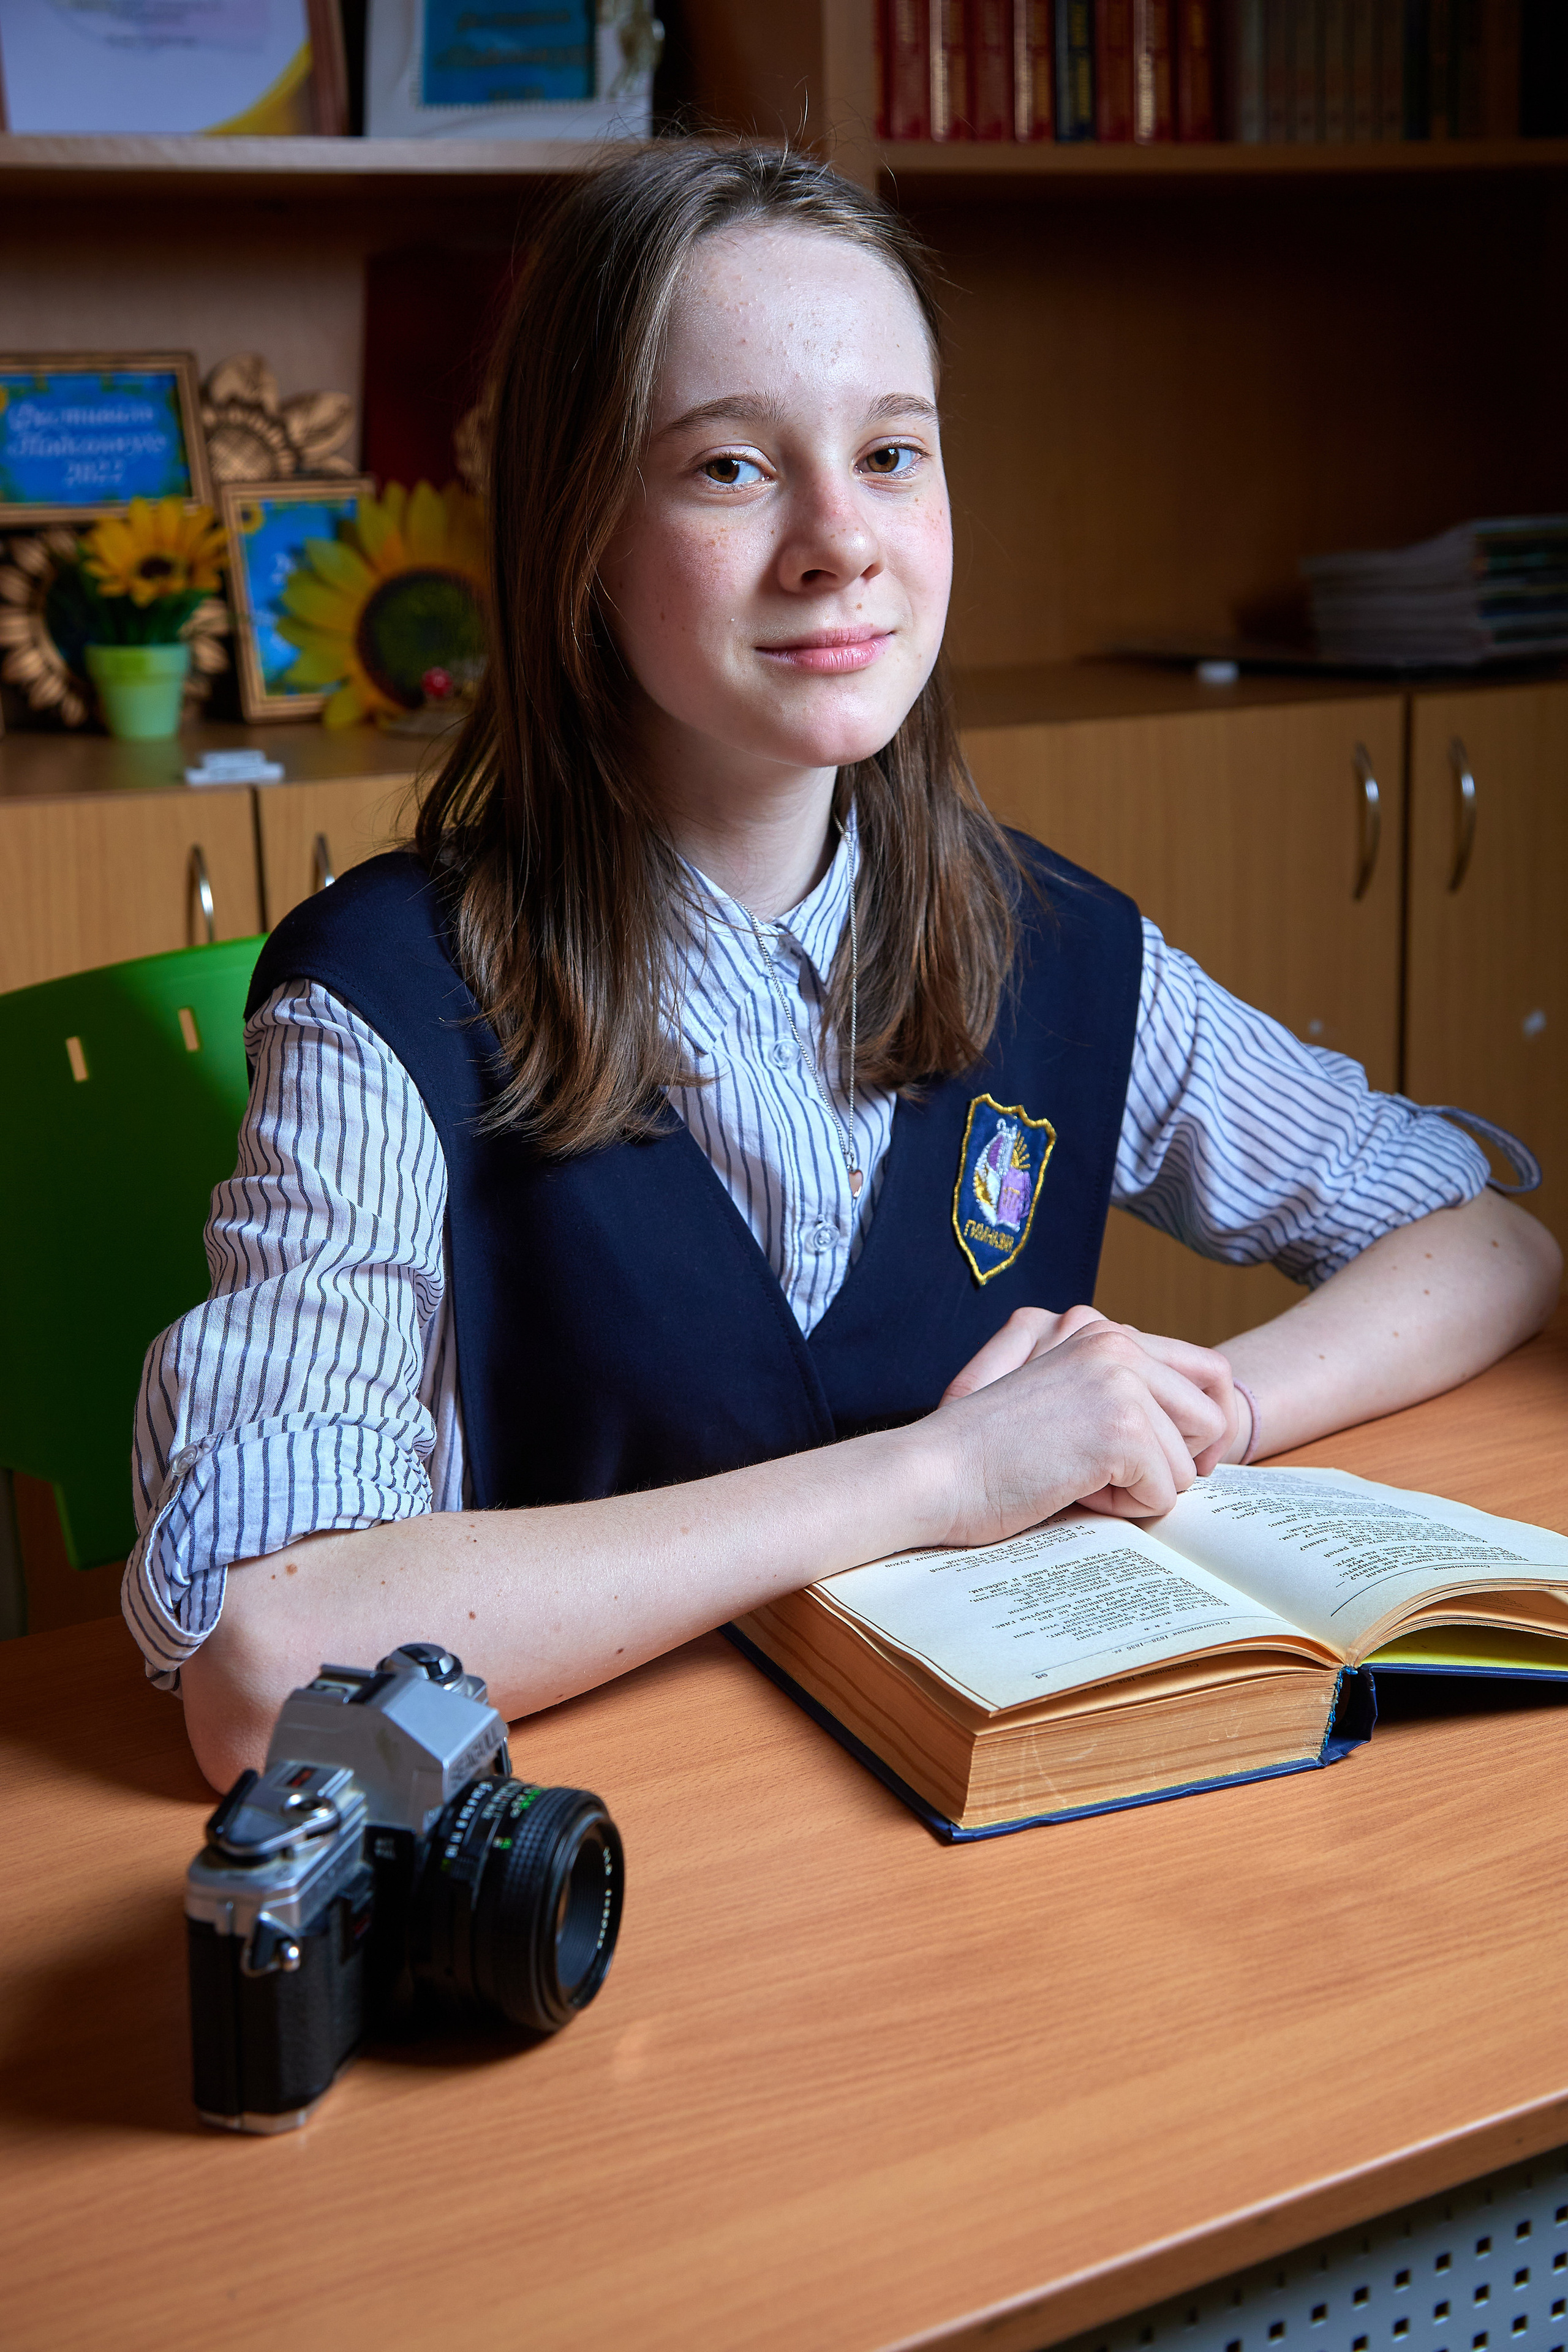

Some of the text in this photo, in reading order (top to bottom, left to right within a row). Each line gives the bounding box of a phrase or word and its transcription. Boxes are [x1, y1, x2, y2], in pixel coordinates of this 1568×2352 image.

[1210, 1500, 1253, 1515] страстей!
[1265, 1518, 1298, 1527] пятно;
[1284, 1524, 1314, 1532] моем;
[1024, 1527, 1066, 1542] Внимали
[1276, 1532, 1299, 1541] том,
[1035, 1536, 1065, 1547] тихую
[1297, 1537, 1329, 1551] дыша?
[1081, 1553, 1109, 1561] чужд
[1322, 1545, 1350, 1558] речей
[983, 1556, 1010, 1564] ангел
[1049, 1560, 1081, 1570] всему,
[1072, 1555, 1120, 1569] возвещает
[1332, 1556, 1357, 1567] звук.
[1344, 1559, 1365, 1567] мук
[928, 1562, 962, 1573] толпой
[1068, 1564, 1102, 1575] башни
[1102, 1563, 1137, 1573] мелкие
[1119, 1563, 1162, 1574] Который
[1336, 1556, 1389, 1577] презирать;
[1346, 1565, 1379, 1580] знать?
[1364, 1564, 1399, 1578] издали
[1020, 1569, 1049, 1578] земле
[1044, 1569, 1070, 1577] миру
[1055, 1572, 1102, 1586] несчастия
[1018, 1567, 1168, 1605] Могильного кургана, мавзолей,
[1025, 1574, 1067, 1588] мрачный
[1050, 1576, 1103, 1592] изменится;
[1133, 1581, 1178, 1593] путникам
[1021, 1585, 1054, 1597] людей
[1079, 1582, 1113, 1593] люблю
[1093, 1585, 1135, 1598] кончины
[967, 1587, 1020, 1604] властелин,
[1071, 1596, 1116, 1610] нравился
[1098, 1597, 1148, 1613] порывным
[1103, 1598, 1128, 1607] небу
[1118, 1596, 1170, 1612] колоколам
[1139, 1601, 1170, 1611] седую
[1018, 1603, 1073, 1621] бессмертья
[1032, 1613, 1054, 1622] раз,
[1062, 1612, 1096, 1624] ветром
[1133, 1610, 1174, 1623] зимнее,
[1060, 1611, 1117, 1630] монастыря?
[1084, 1612, 1129, 1627] трепетом
[1096, 1615, 1136, 1629] красная
[1037, 1623, 1061, 1632] этот
[1071, 1627, 1095, 1637] заря
[1105, 1621, 1134, 1631] когда
[1171, 1621, 1231, 1636] Стихотворения
[1011, 1630, 1036, 1639] звон
[1044, 1626, 1083, 1639] глядит,
[1073, 1630, 1104, 1641] валит
[1125, 1635, 1170, 1651] 1828—1836
